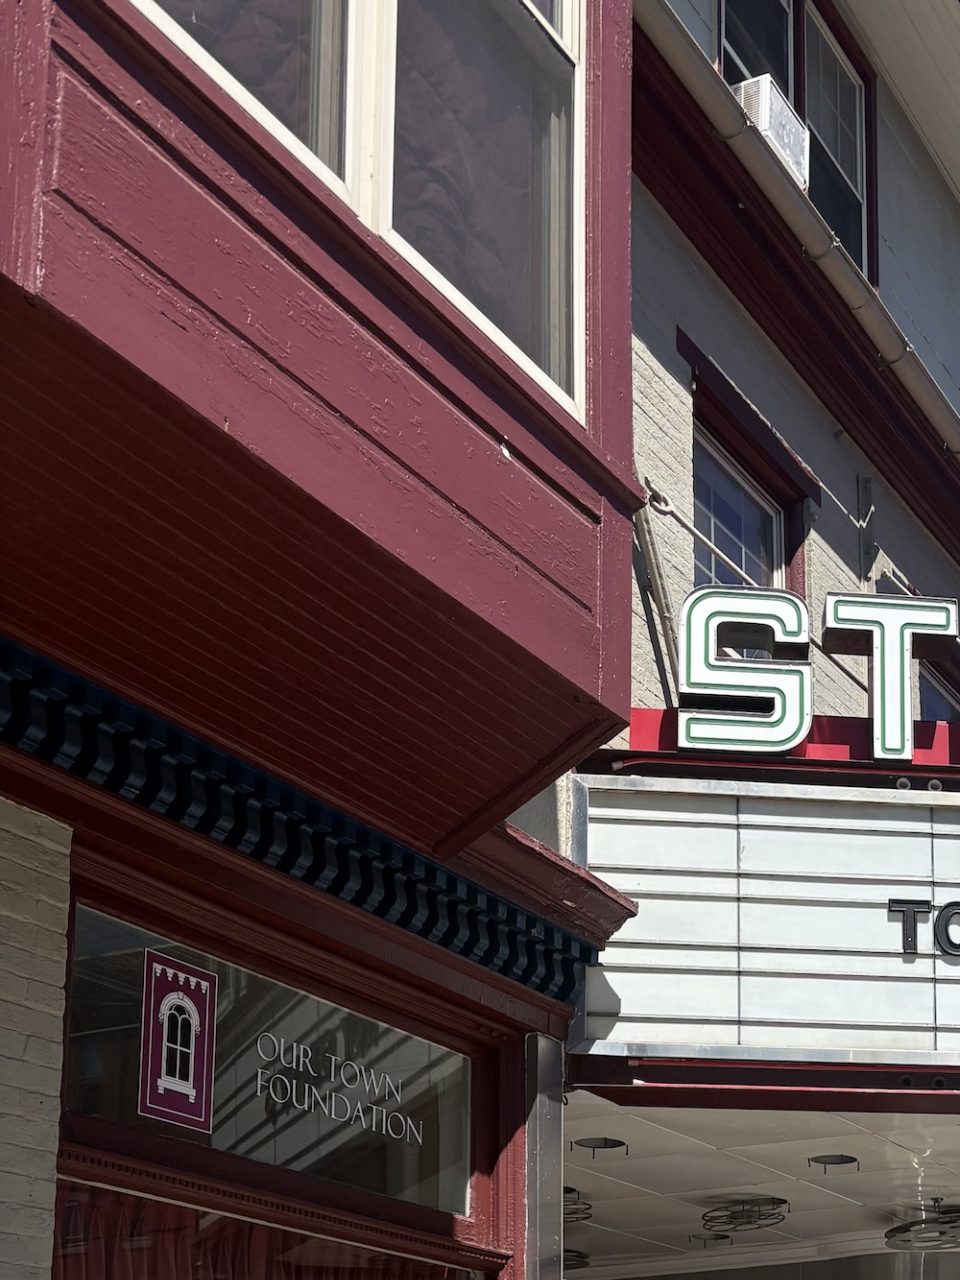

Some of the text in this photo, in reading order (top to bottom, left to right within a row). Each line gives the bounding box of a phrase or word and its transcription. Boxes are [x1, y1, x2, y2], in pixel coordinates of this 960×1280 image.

[257, 1032, 402, 1104] OUR TOWN
[256, 1068, 423, 1145] FOUNDATION
